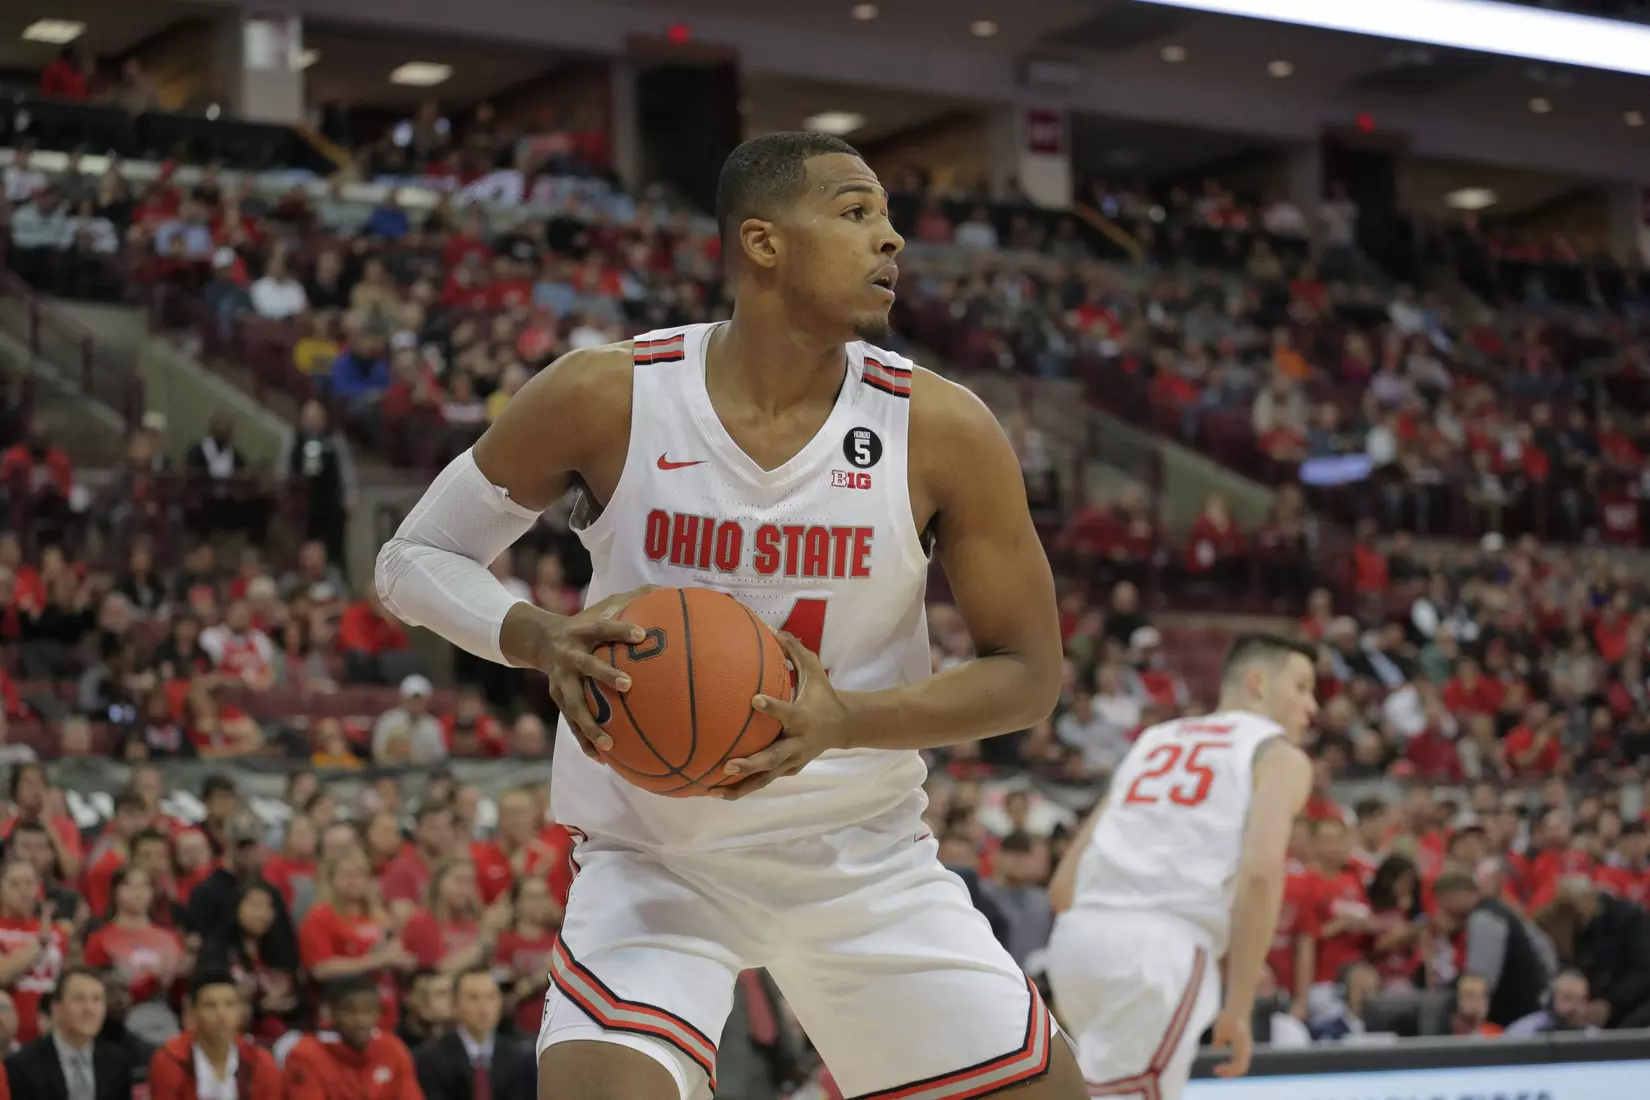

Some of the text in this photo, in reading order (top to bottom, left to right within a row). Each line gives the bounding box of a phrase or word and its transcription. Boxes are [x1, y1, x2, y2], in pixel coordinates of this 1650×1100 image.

[854, 438, 871, 466] 5
[645, 509, 874, 579] OHIO STATE
[1123, 742, 1234, 808] 25
